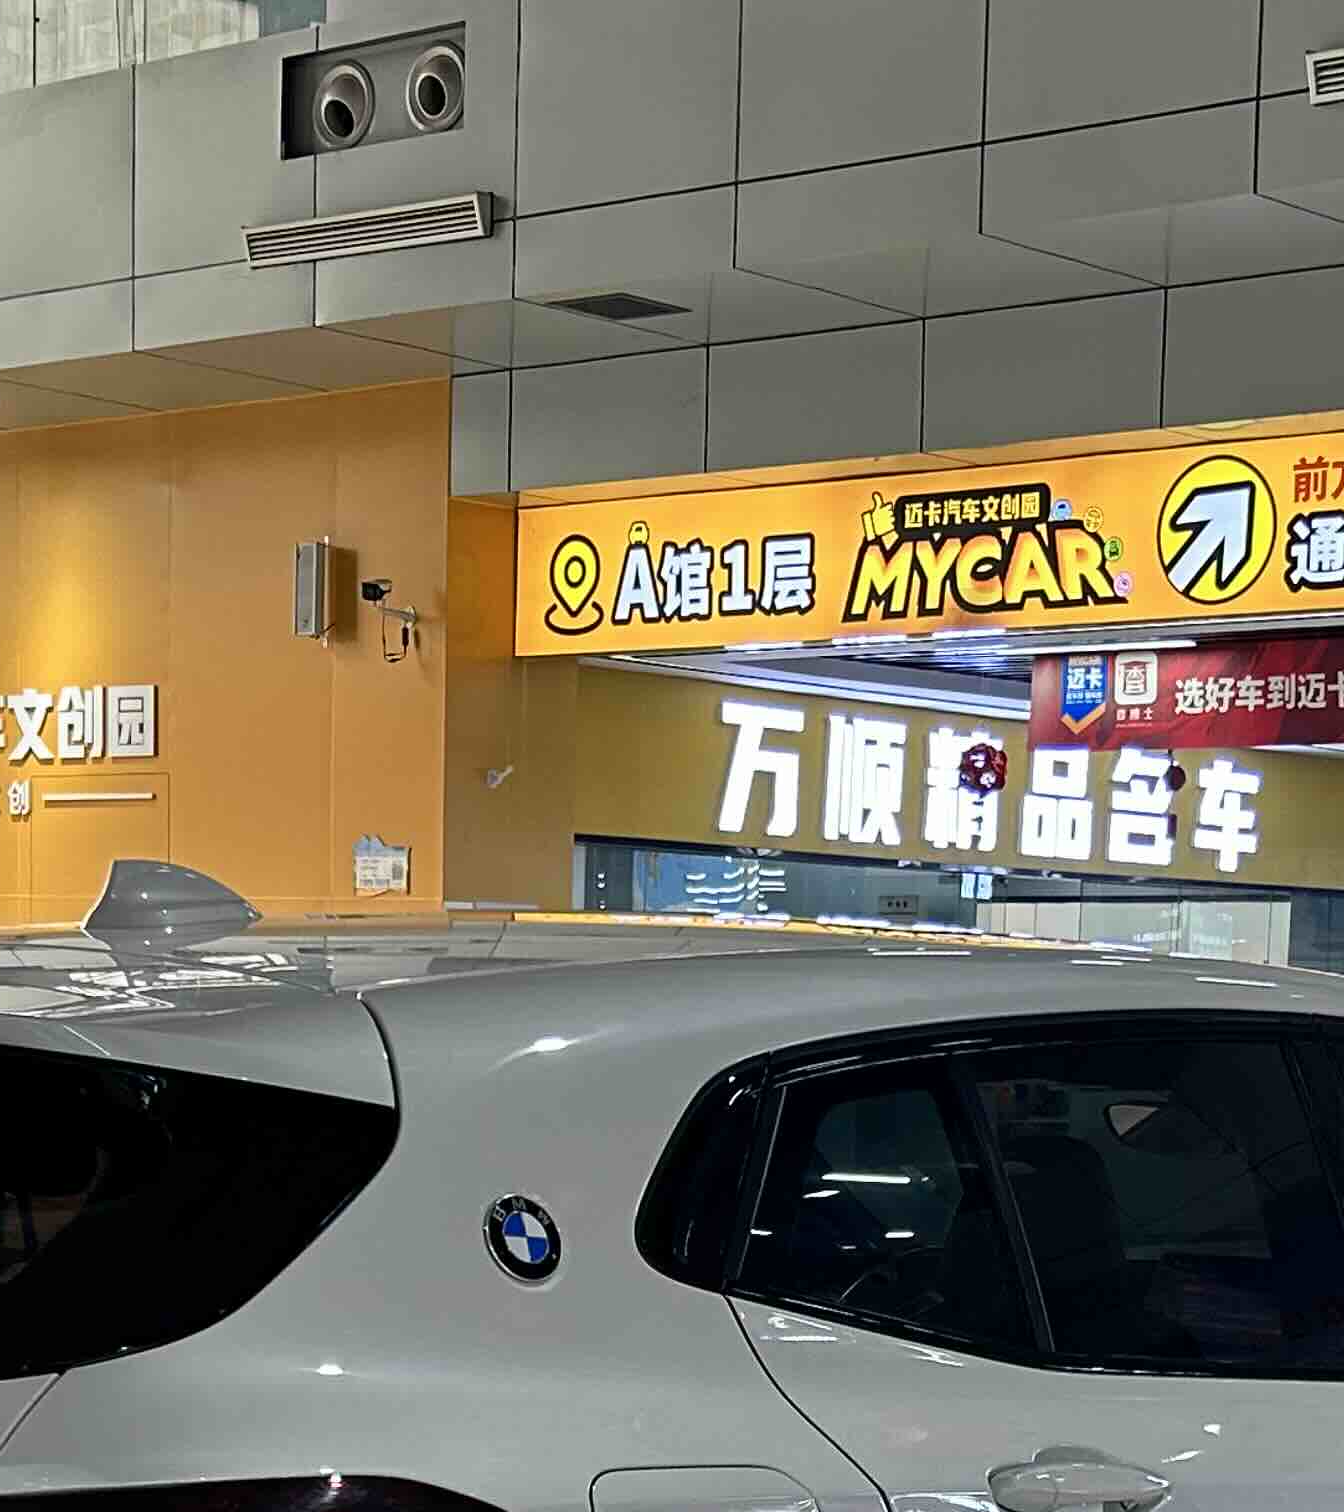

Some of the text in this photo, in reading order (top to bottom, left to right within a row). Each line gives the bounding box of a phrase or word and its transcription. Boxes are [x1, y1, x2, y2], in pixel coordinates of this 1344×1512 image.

[902, 490, 1042, 531] 迈卡汽车文创园
[613, 534, 816, 624] A馆1层
[845, 526, 1126, 622] MYCAR
[717, 700, 1262, 873] 万顺精品名车
